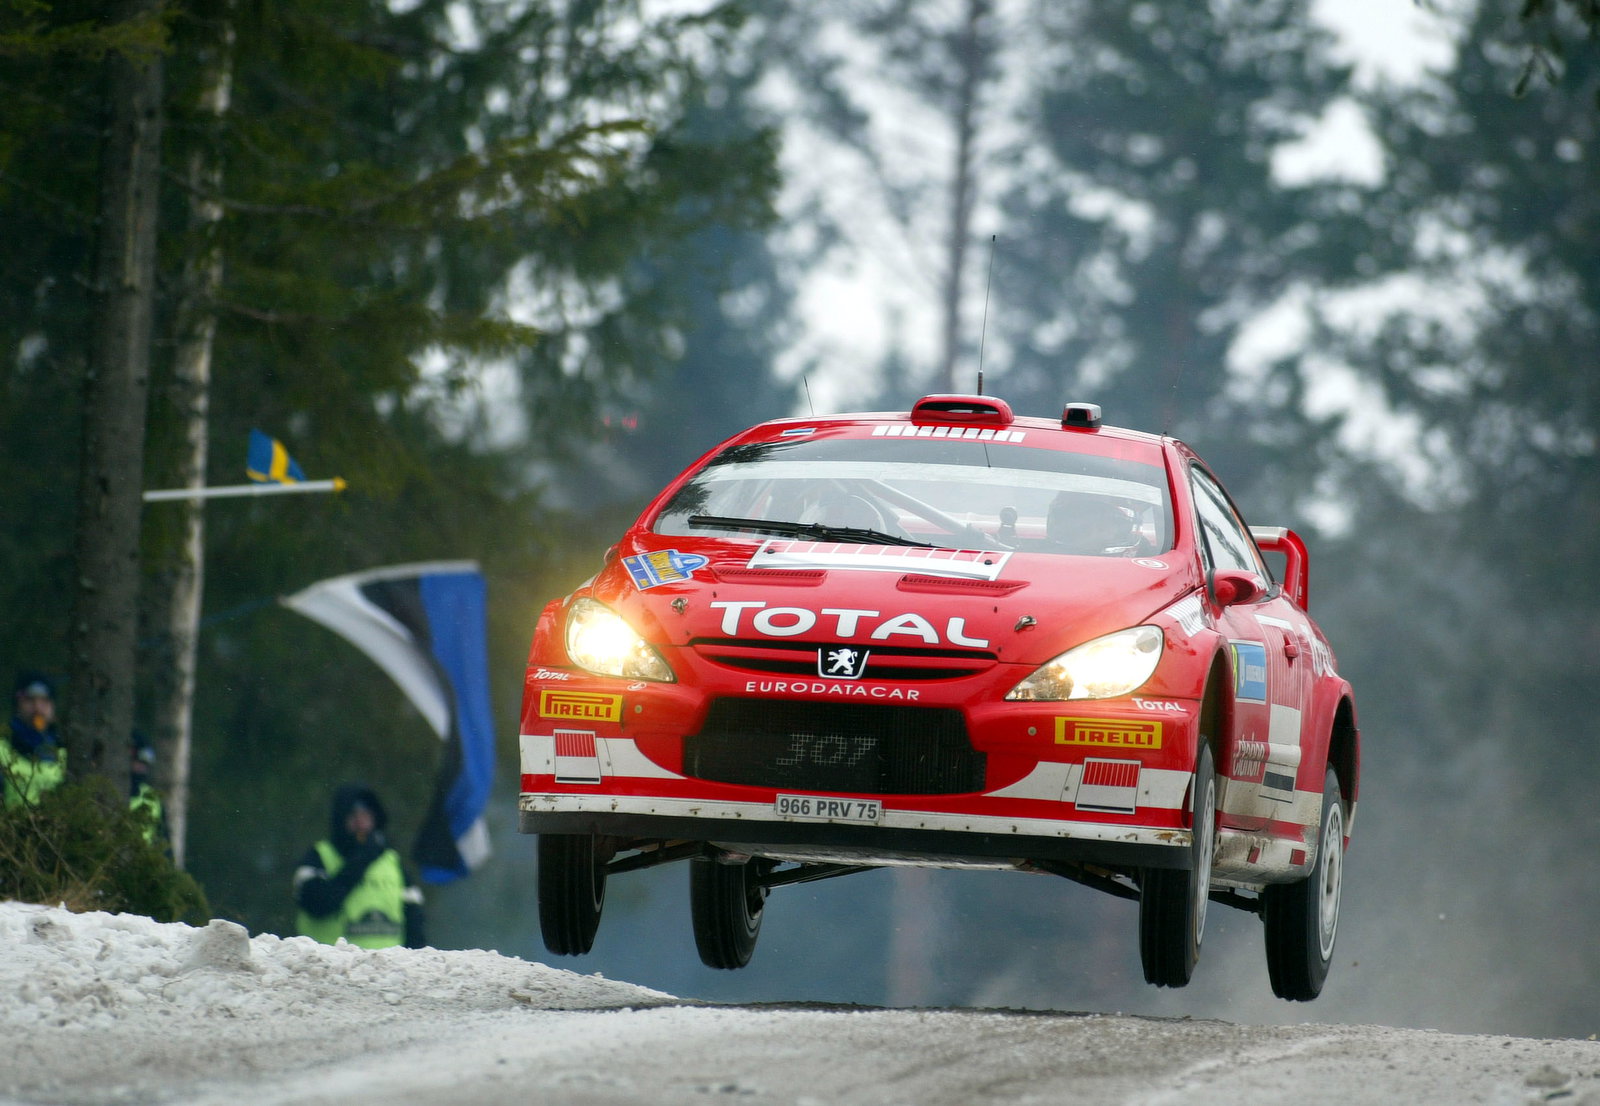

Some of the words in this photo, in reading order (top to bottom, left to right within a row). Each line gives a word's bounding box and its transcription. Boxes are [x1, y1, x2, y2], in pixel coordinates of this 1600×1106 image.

[709, 601, 990, 649] TOTAL
[534, 669, 569, 681] TOTAL
[745, 681, 920, 701] EURODATACAR
[545, 693, 614, 718] PIRELLI
[1131, 698, 1187, 712] TOTAL
[1064, 720, 1155, 746] PIRELLI
[780, 798, 811, 816] 966
[816, 800, 852, 818] PRV
[857, 803, 877, 819] 75
